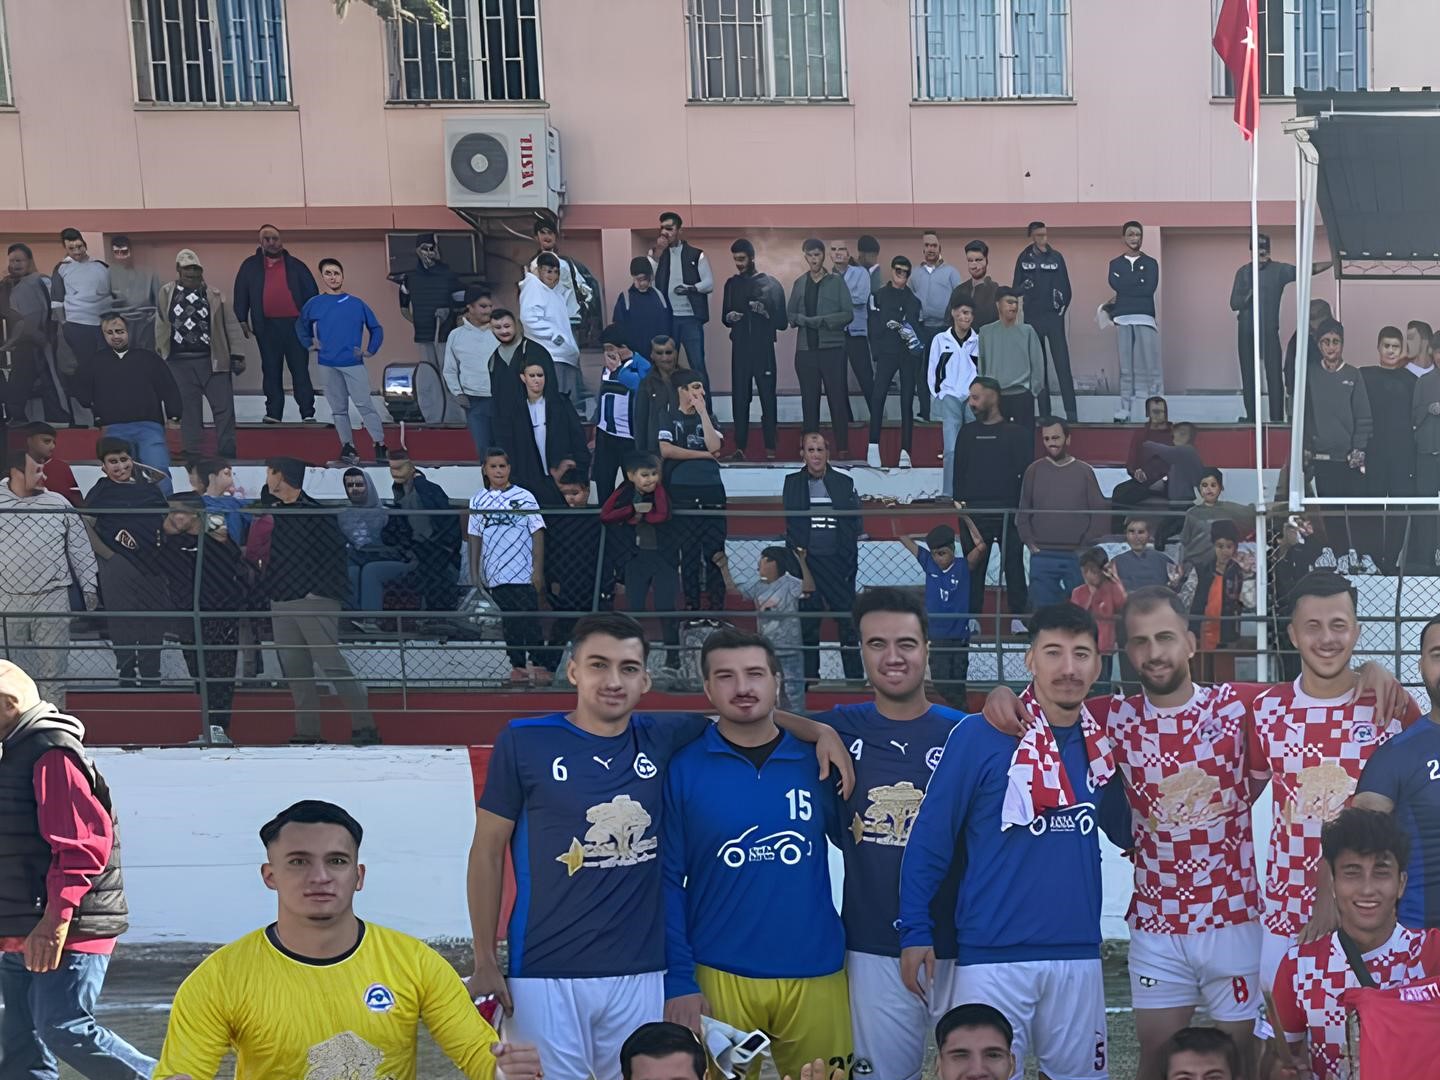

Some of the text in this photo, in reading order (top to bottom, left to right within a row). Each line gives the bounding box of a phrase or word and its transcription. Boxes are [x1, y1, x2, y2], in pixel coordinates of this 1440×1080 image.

[552, 756, 568, 782] 6
[785, 788, 813, 821] 15
[1232, 975, 1249, 1004] 8
